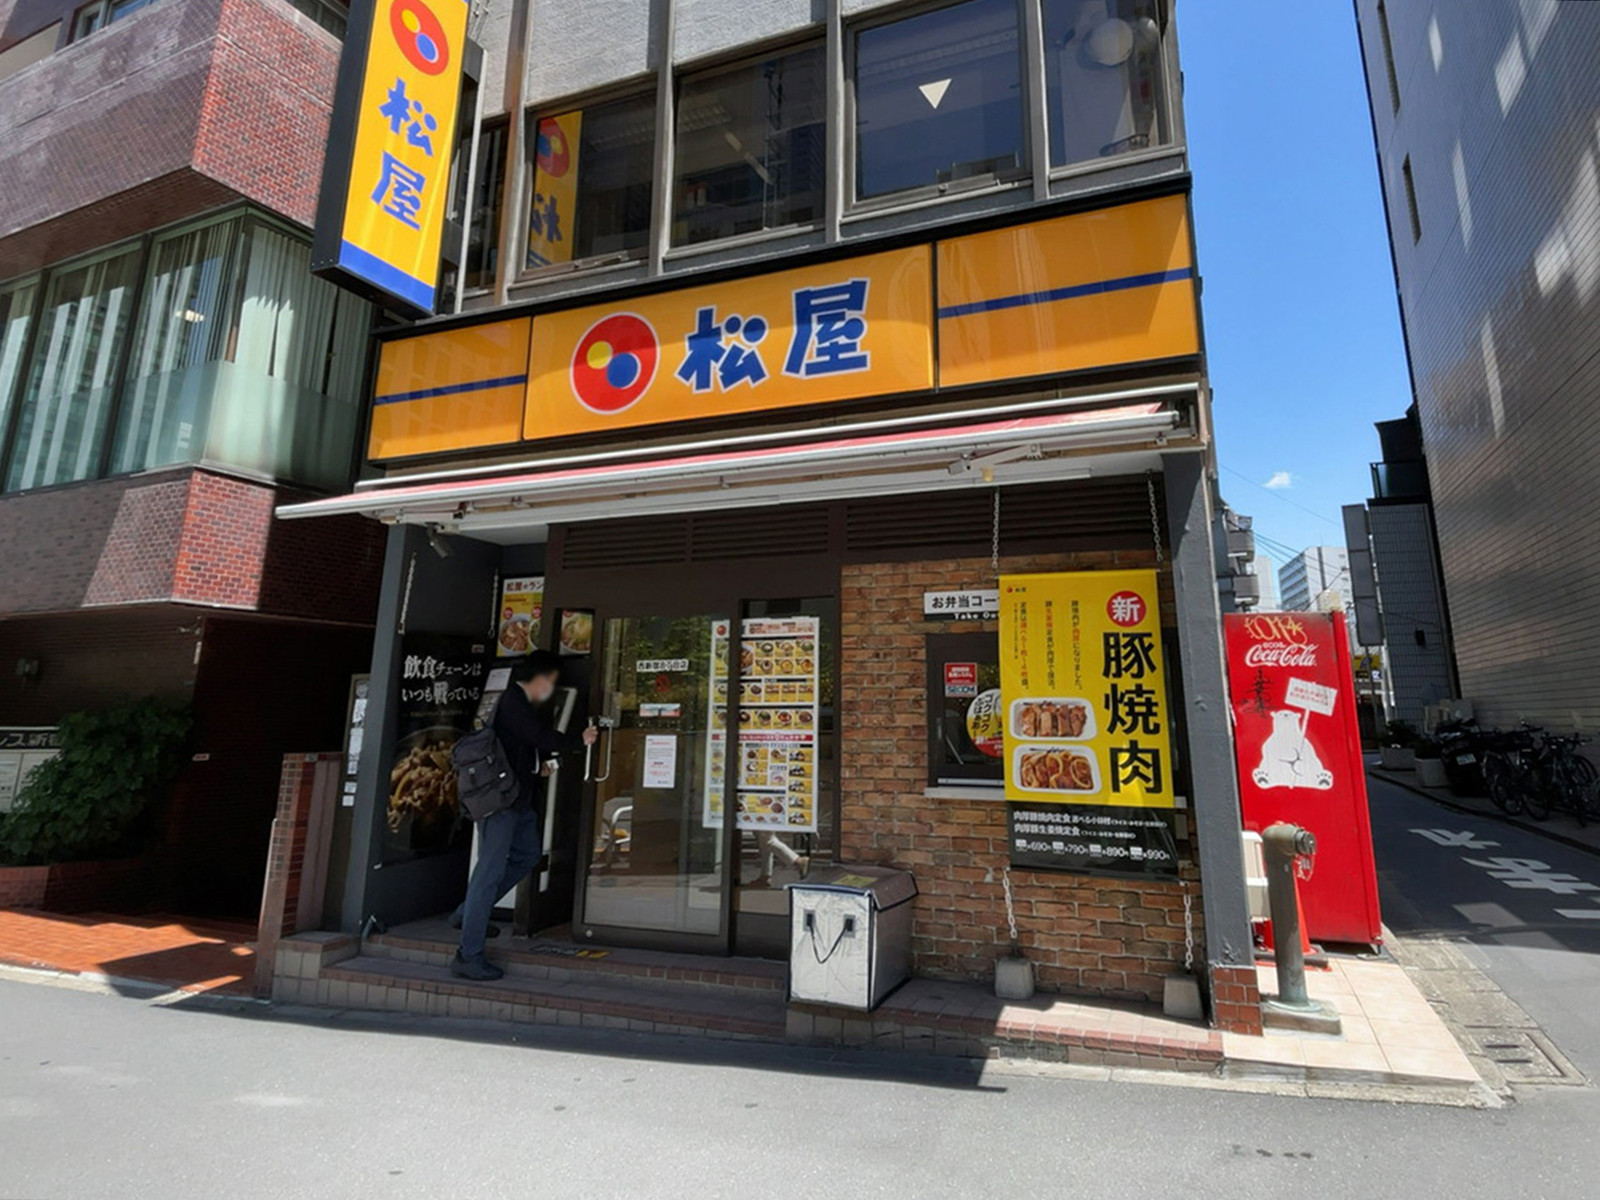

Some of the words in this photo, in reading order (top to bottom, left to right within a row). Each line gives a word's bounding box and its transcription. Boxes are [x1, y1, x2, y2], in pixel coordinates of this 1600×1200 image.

[370, 77, 438, 231] 松屋
[673, 277, 872, 395] 松屋
[932, 594, 999, 609] お弁当コー
[1111, 600, 1142, 622] 新
[983, 611, 998, 620] Ou
[403, 654, 482, 679] 飲食チェーンは
[1245, 644, 1320, 667] Coca-Cola
[401, 681, 480, 705] いつも戦っている
[1101, 631, 1164, 796] 豚焼肉
